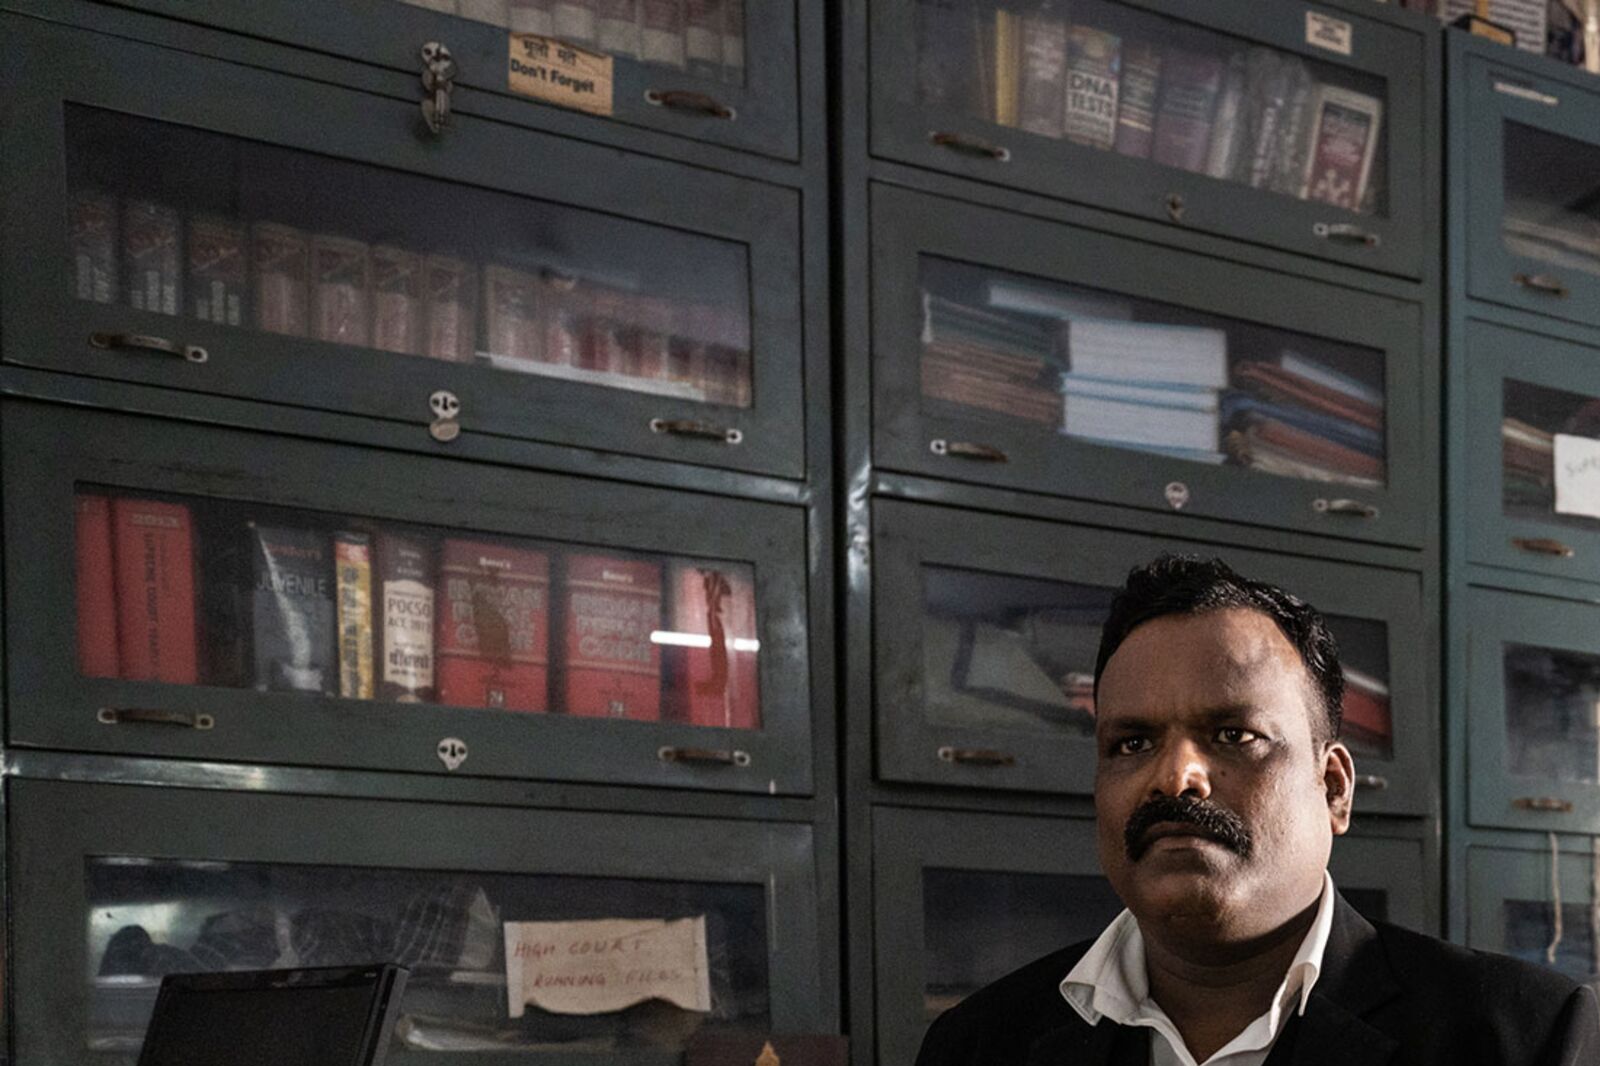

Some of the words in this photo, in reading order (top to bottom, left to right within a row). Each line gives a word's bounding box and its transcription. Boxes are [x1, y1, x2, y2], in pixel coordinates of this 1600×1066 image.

[510, 58, 547, 81] Don't
[550, 69, 595, 93] Forget
[1070, 74, 1113, 98] DNA
[1071, 93, 1113, 118] TESTS
[387, 597, 432, 621] POCSO
[514, 939, 556, 958] HIGH
[568, 938, 645, 956] COURT
[534, 970, 607, 989] RUNNING
